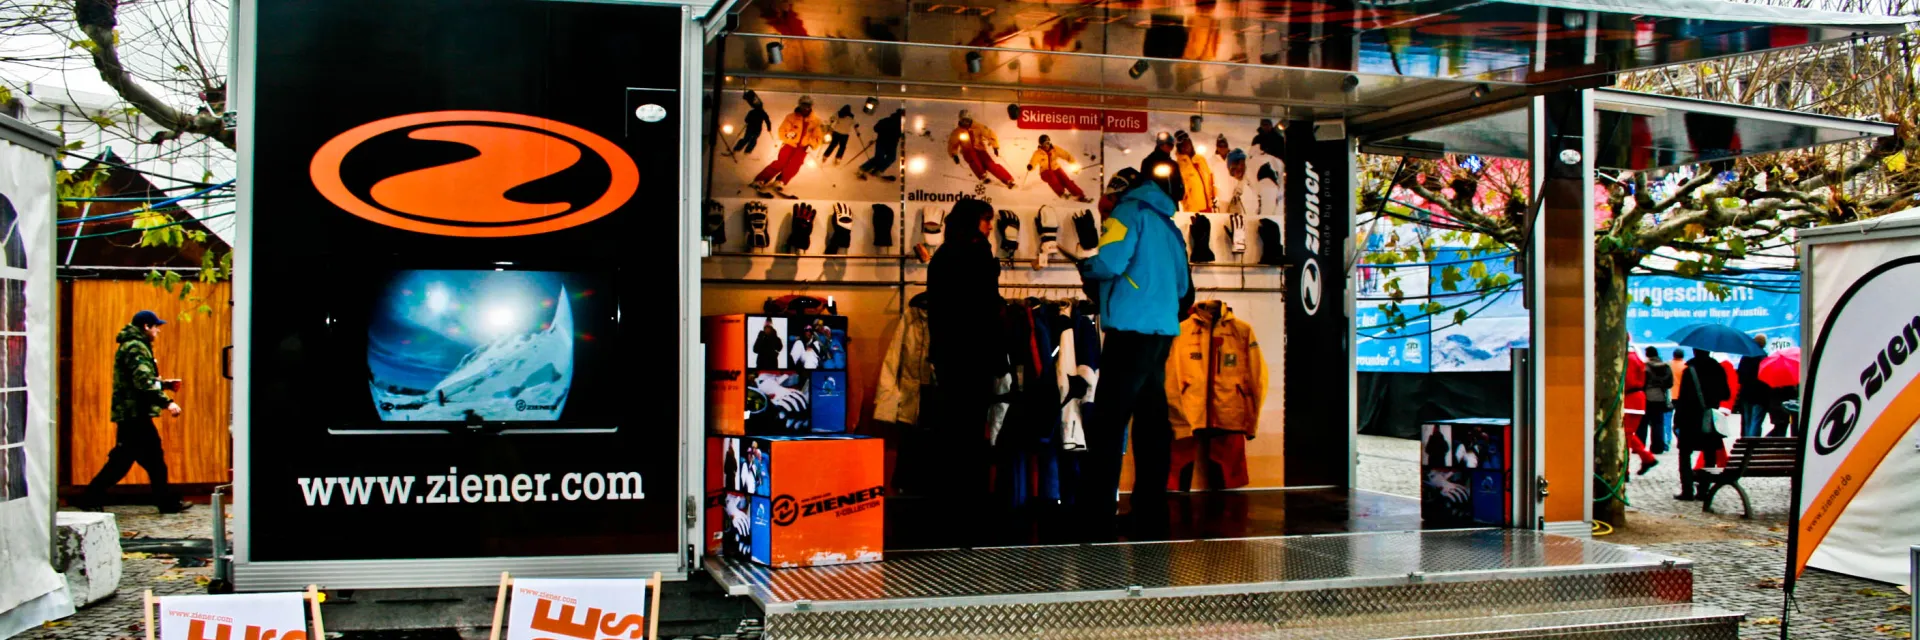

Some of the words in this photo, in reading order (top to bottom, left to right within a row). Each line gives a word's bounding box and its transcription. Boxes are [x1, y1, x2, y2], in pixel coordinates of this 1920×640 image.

[1021, 109, 1076, 125] Skireisen
[1079, 113, 1098, 126] mit
[1107, 115, 1141, 129] Profis
[1323, 169, 1332, 198] pros
[1304, 160, 1320, 256] ziener
[1323, 204, 1333, 219] by
[1323, 223, 1332, 256] made
[298, 467, 645, 506] www.ziener.com
[801, 486, 884, 517] ZIENER
[1806, 473, 1853, 533] www.ziener.de
[168, 608, 234, 623] www.ziener.com
